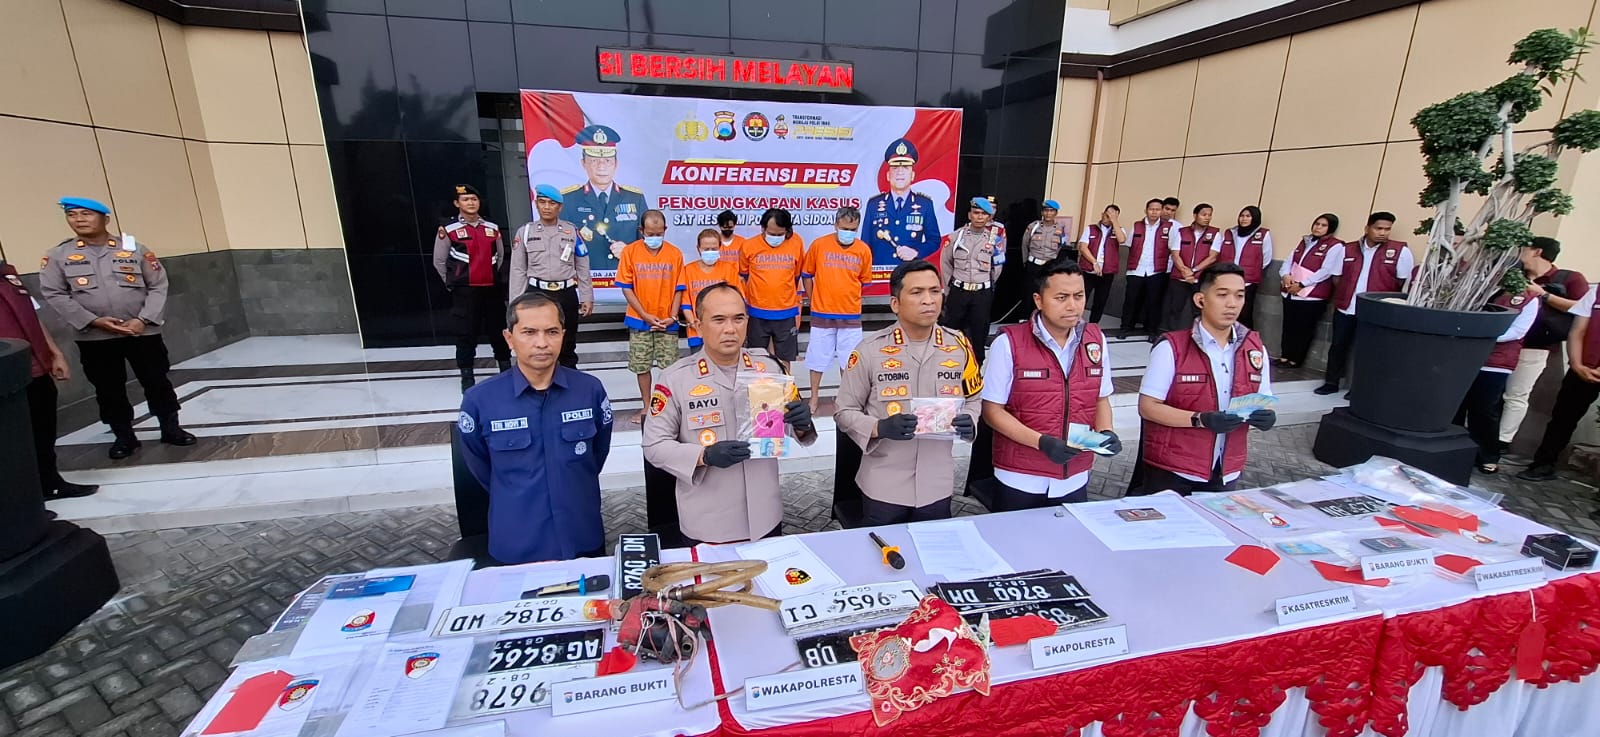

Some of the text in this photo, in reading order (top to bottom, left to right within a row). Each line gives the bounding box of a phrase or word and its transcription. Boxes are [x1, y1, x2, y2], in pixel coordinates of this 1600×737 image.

[599, 52, 853, 88] SI BERSIH MELAYAN
[670, 166, 851, 183] KONFERENSI PERS
[658, 197, 860, 210] PENGUNGKAPAN KASUS
[673, 214, 836, 227] SAT RESM POTA SIDOA
[755, 254, 794, 264] TAHANAN
[825, 251, 861, 265] TAHANAN
[877, 372, 910, 382] C.TOBING
[689, 398, 718, 410] BAYU
[622, 537, 646, 552] DM
[1374, 557, 1428, 571] BARANG BUKTI
[1482, 565, 1543, 581] WAKASATRESKRIM
[902, 588, 920, 602] L
[947, 590, 977, 604] DM
[996, 585, 1051, 601] 8760
[836, 593, 891, 615] 9654
[1076, 603, 1101, 618] L
[1288, 595, 1350, 615] KASATRESKRIM
[450, 607, 564, 632] 9184 WD
[1051, 637, 1116, 655] KAPOLRESTA
[488, 638, 599, 672] AG 8464
[805, 645, 837, 667] DB
[575, 679, 668, 702] BARANG BUKTI
[761, 674, 857, 697] WAKAPOLRESTA
[470, 680, 547, 712] 9678
